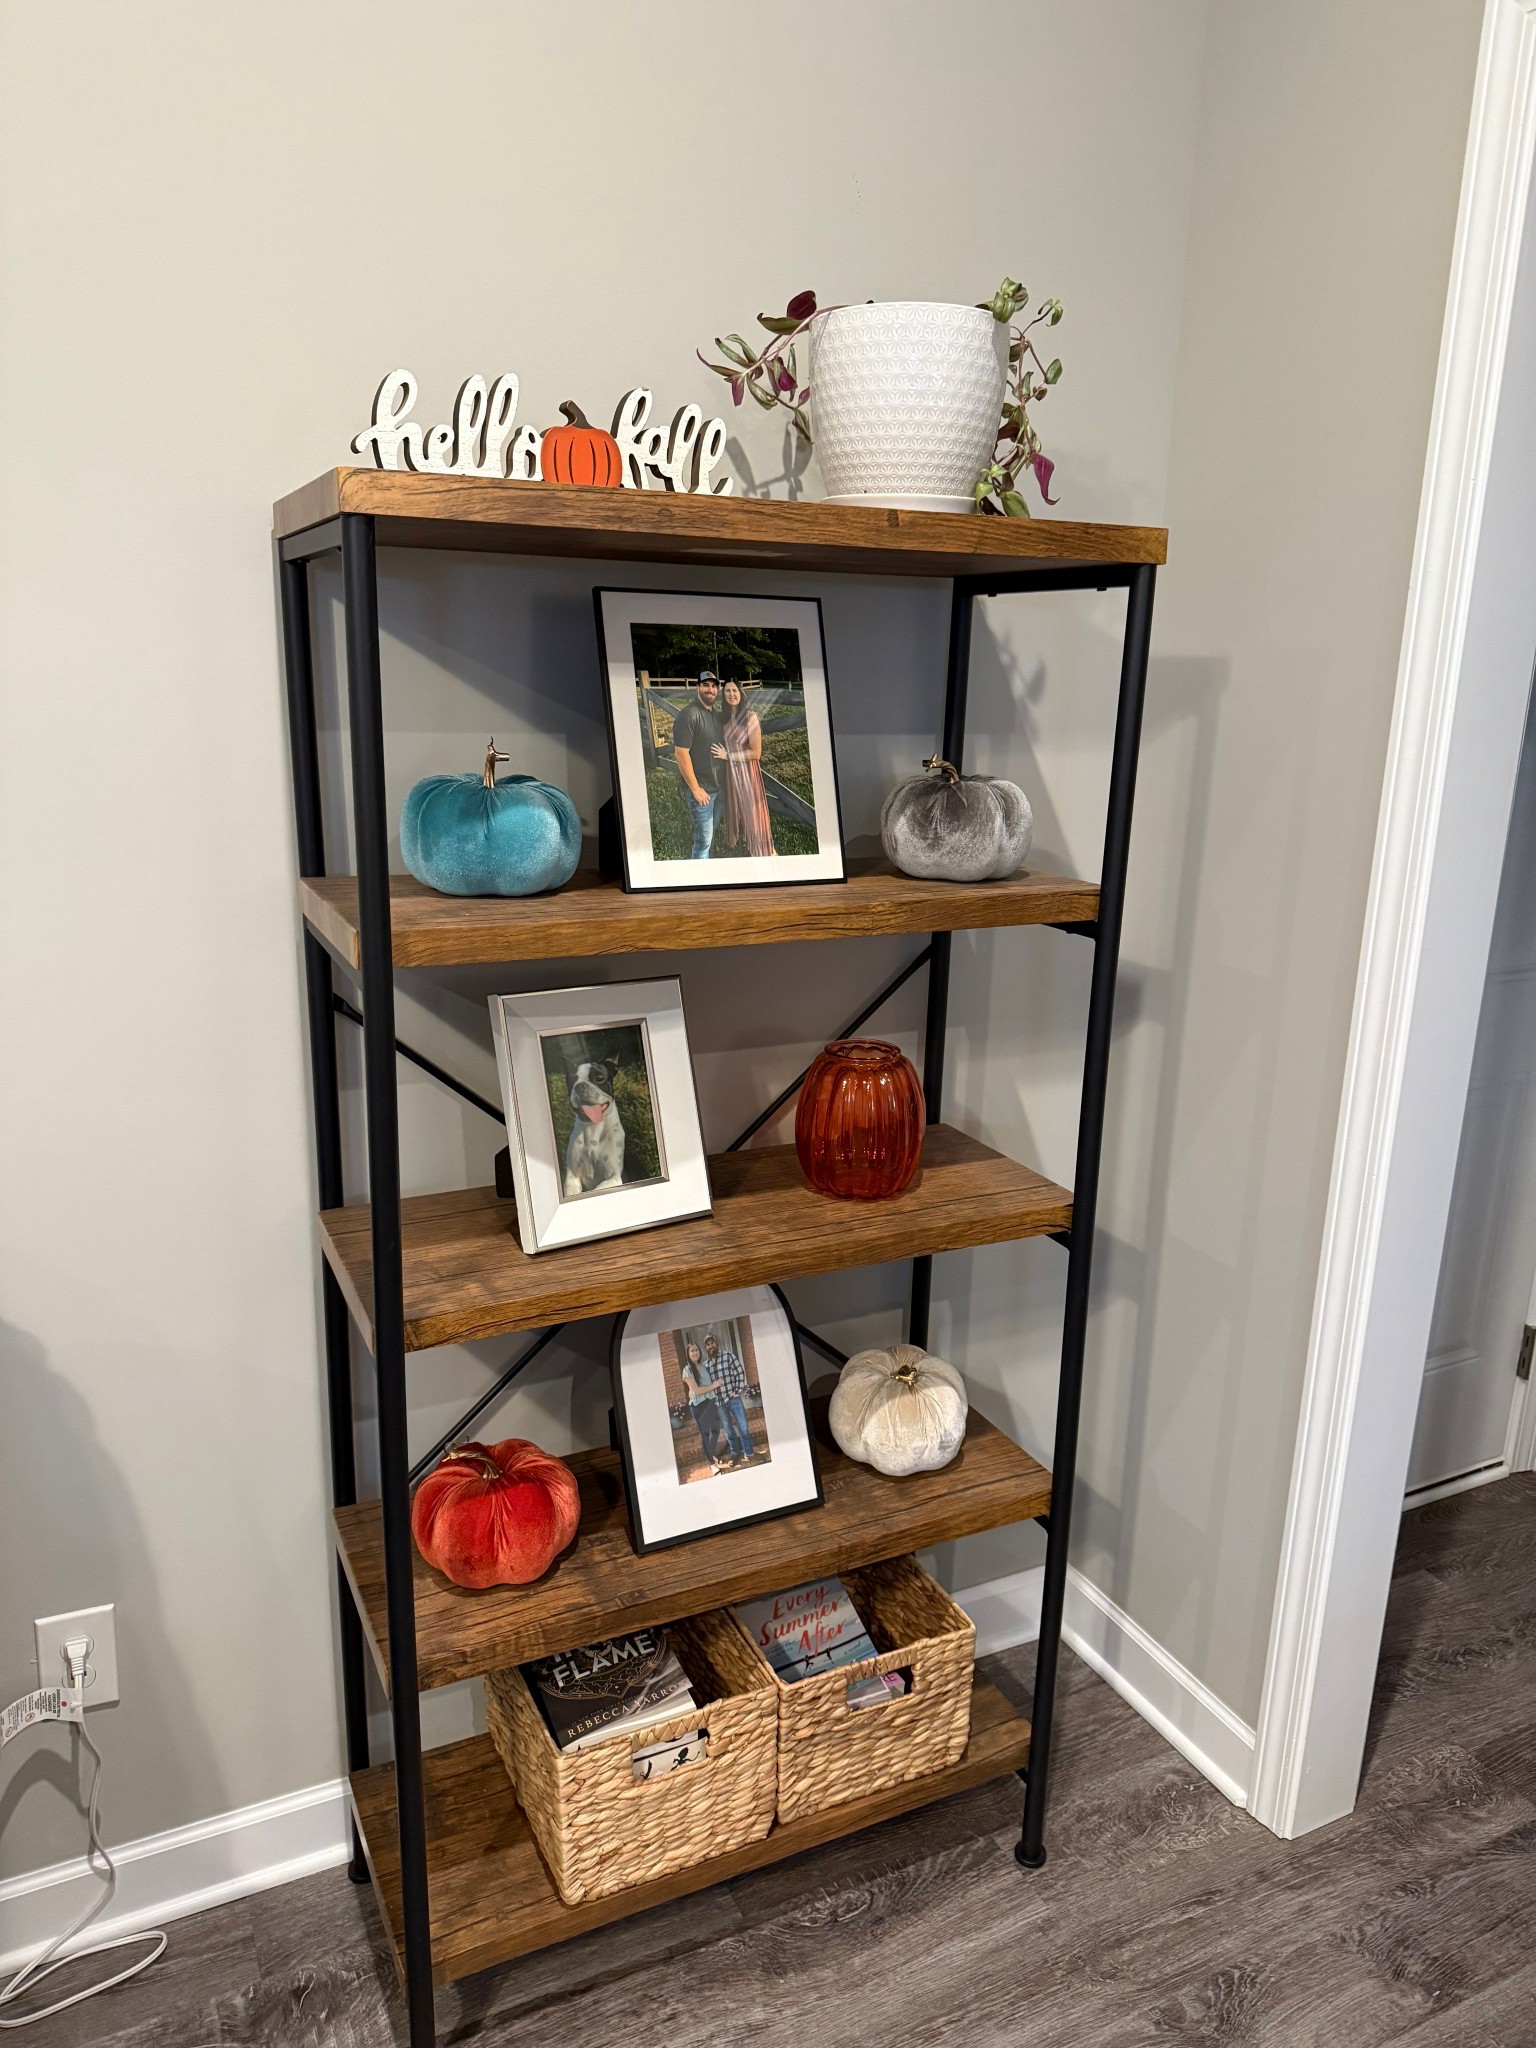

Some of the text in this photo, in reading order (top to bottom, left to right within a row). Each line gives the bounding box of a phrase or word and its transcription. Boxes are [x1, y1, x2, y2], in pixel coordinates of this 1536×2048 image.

[350, 368, 734, 497] hello fall
[760, 1597, 842, 1646] Summer
[773, 1586, 831, 1620] Every
[553, 1634, 655, 1687] FLAME
[798, 1619, 846, 1658] After
[567, 1705, 630, 1738] REBECCA
[634, 1681, 685, 1707] YARROS
